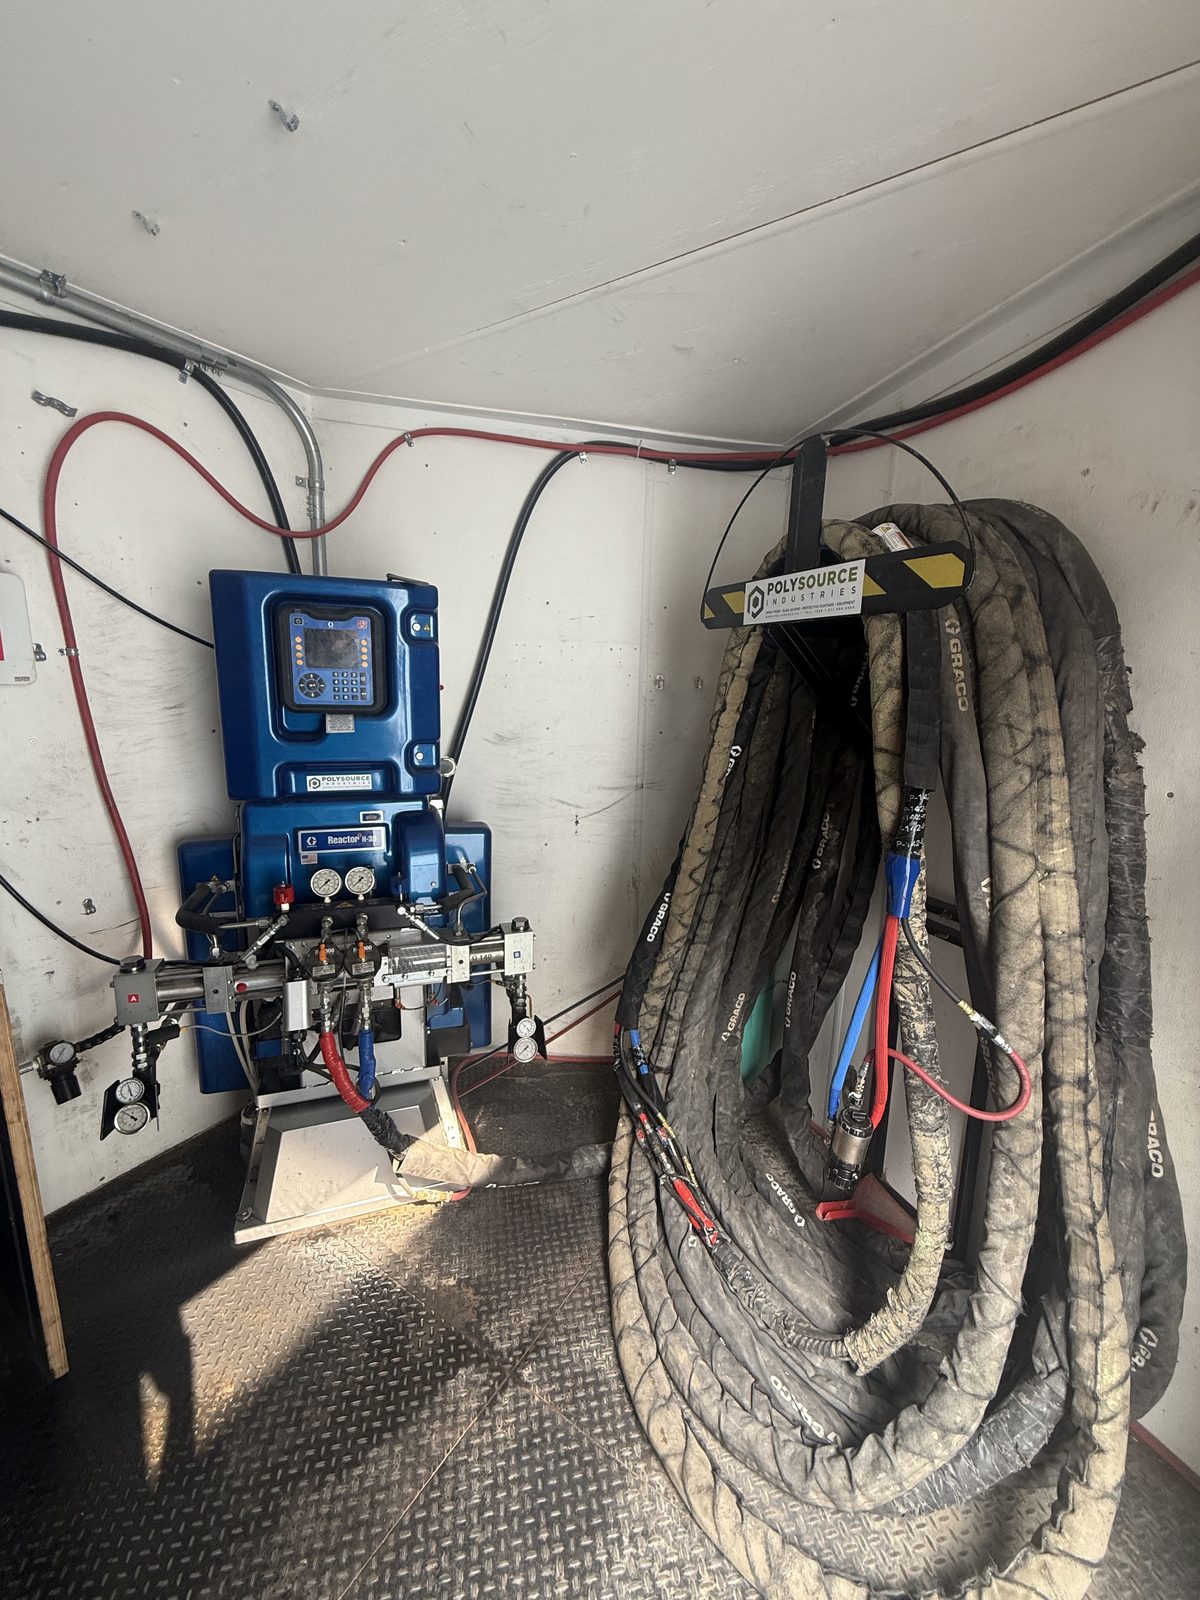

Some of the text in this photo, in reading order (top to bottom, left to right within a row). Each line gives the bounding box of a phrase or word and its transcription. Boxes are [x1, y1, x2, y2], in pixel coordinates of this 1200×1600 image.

[766, 586, 856, 606] INDUSTRIES
[767, 566, 858, 595] POLYSOURCE
[949, 638, 968, 711] GRACO
[327, 835, 360, 845] Reactor
[817, 813, 829, 856] GRACO
[646, 903, 669, 942] GRACO
[727, 993, 746, 1031] GRACO
[786, 971, 797, 1016] GRACO
[765, 1173, 797, 1214] GRACO
